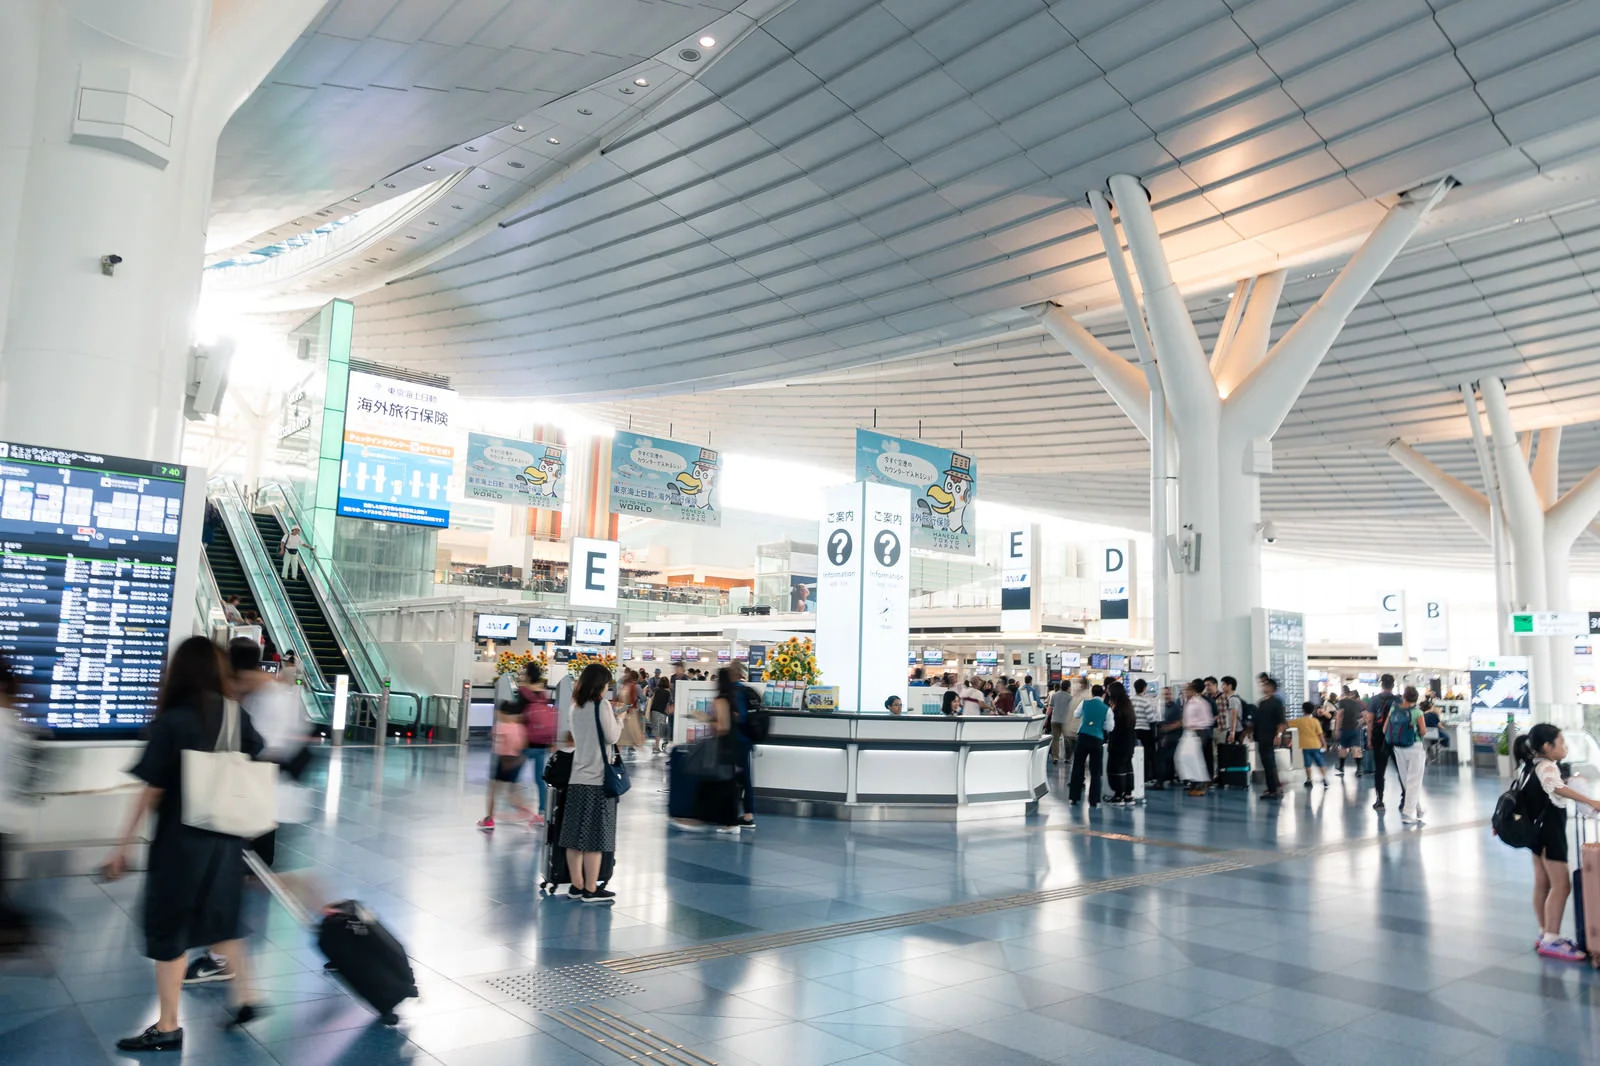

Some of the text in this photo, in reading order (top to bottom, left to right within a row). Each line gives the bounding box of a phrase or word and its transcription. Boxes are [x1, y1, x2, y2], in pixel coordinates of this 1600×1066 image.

[357, 396, 449, 427] 海外旅行保険
[618, 502, 653, 513] WORLD
[827, 510, 854, 524] ご案内
[874, 510, 903, 526] ご案内
[1010, 530, 1024, 558] E
[1105, 548, 1124, 572] D
[585, 551, 607, 591] E
[1382, 594, 1397, 612] C
[1427, 601, 1440, 619] B
[486, 622, 502, 630] ANA
[536, 625, 552, 633] ANA
[583, 628, 598, 636] ANA
